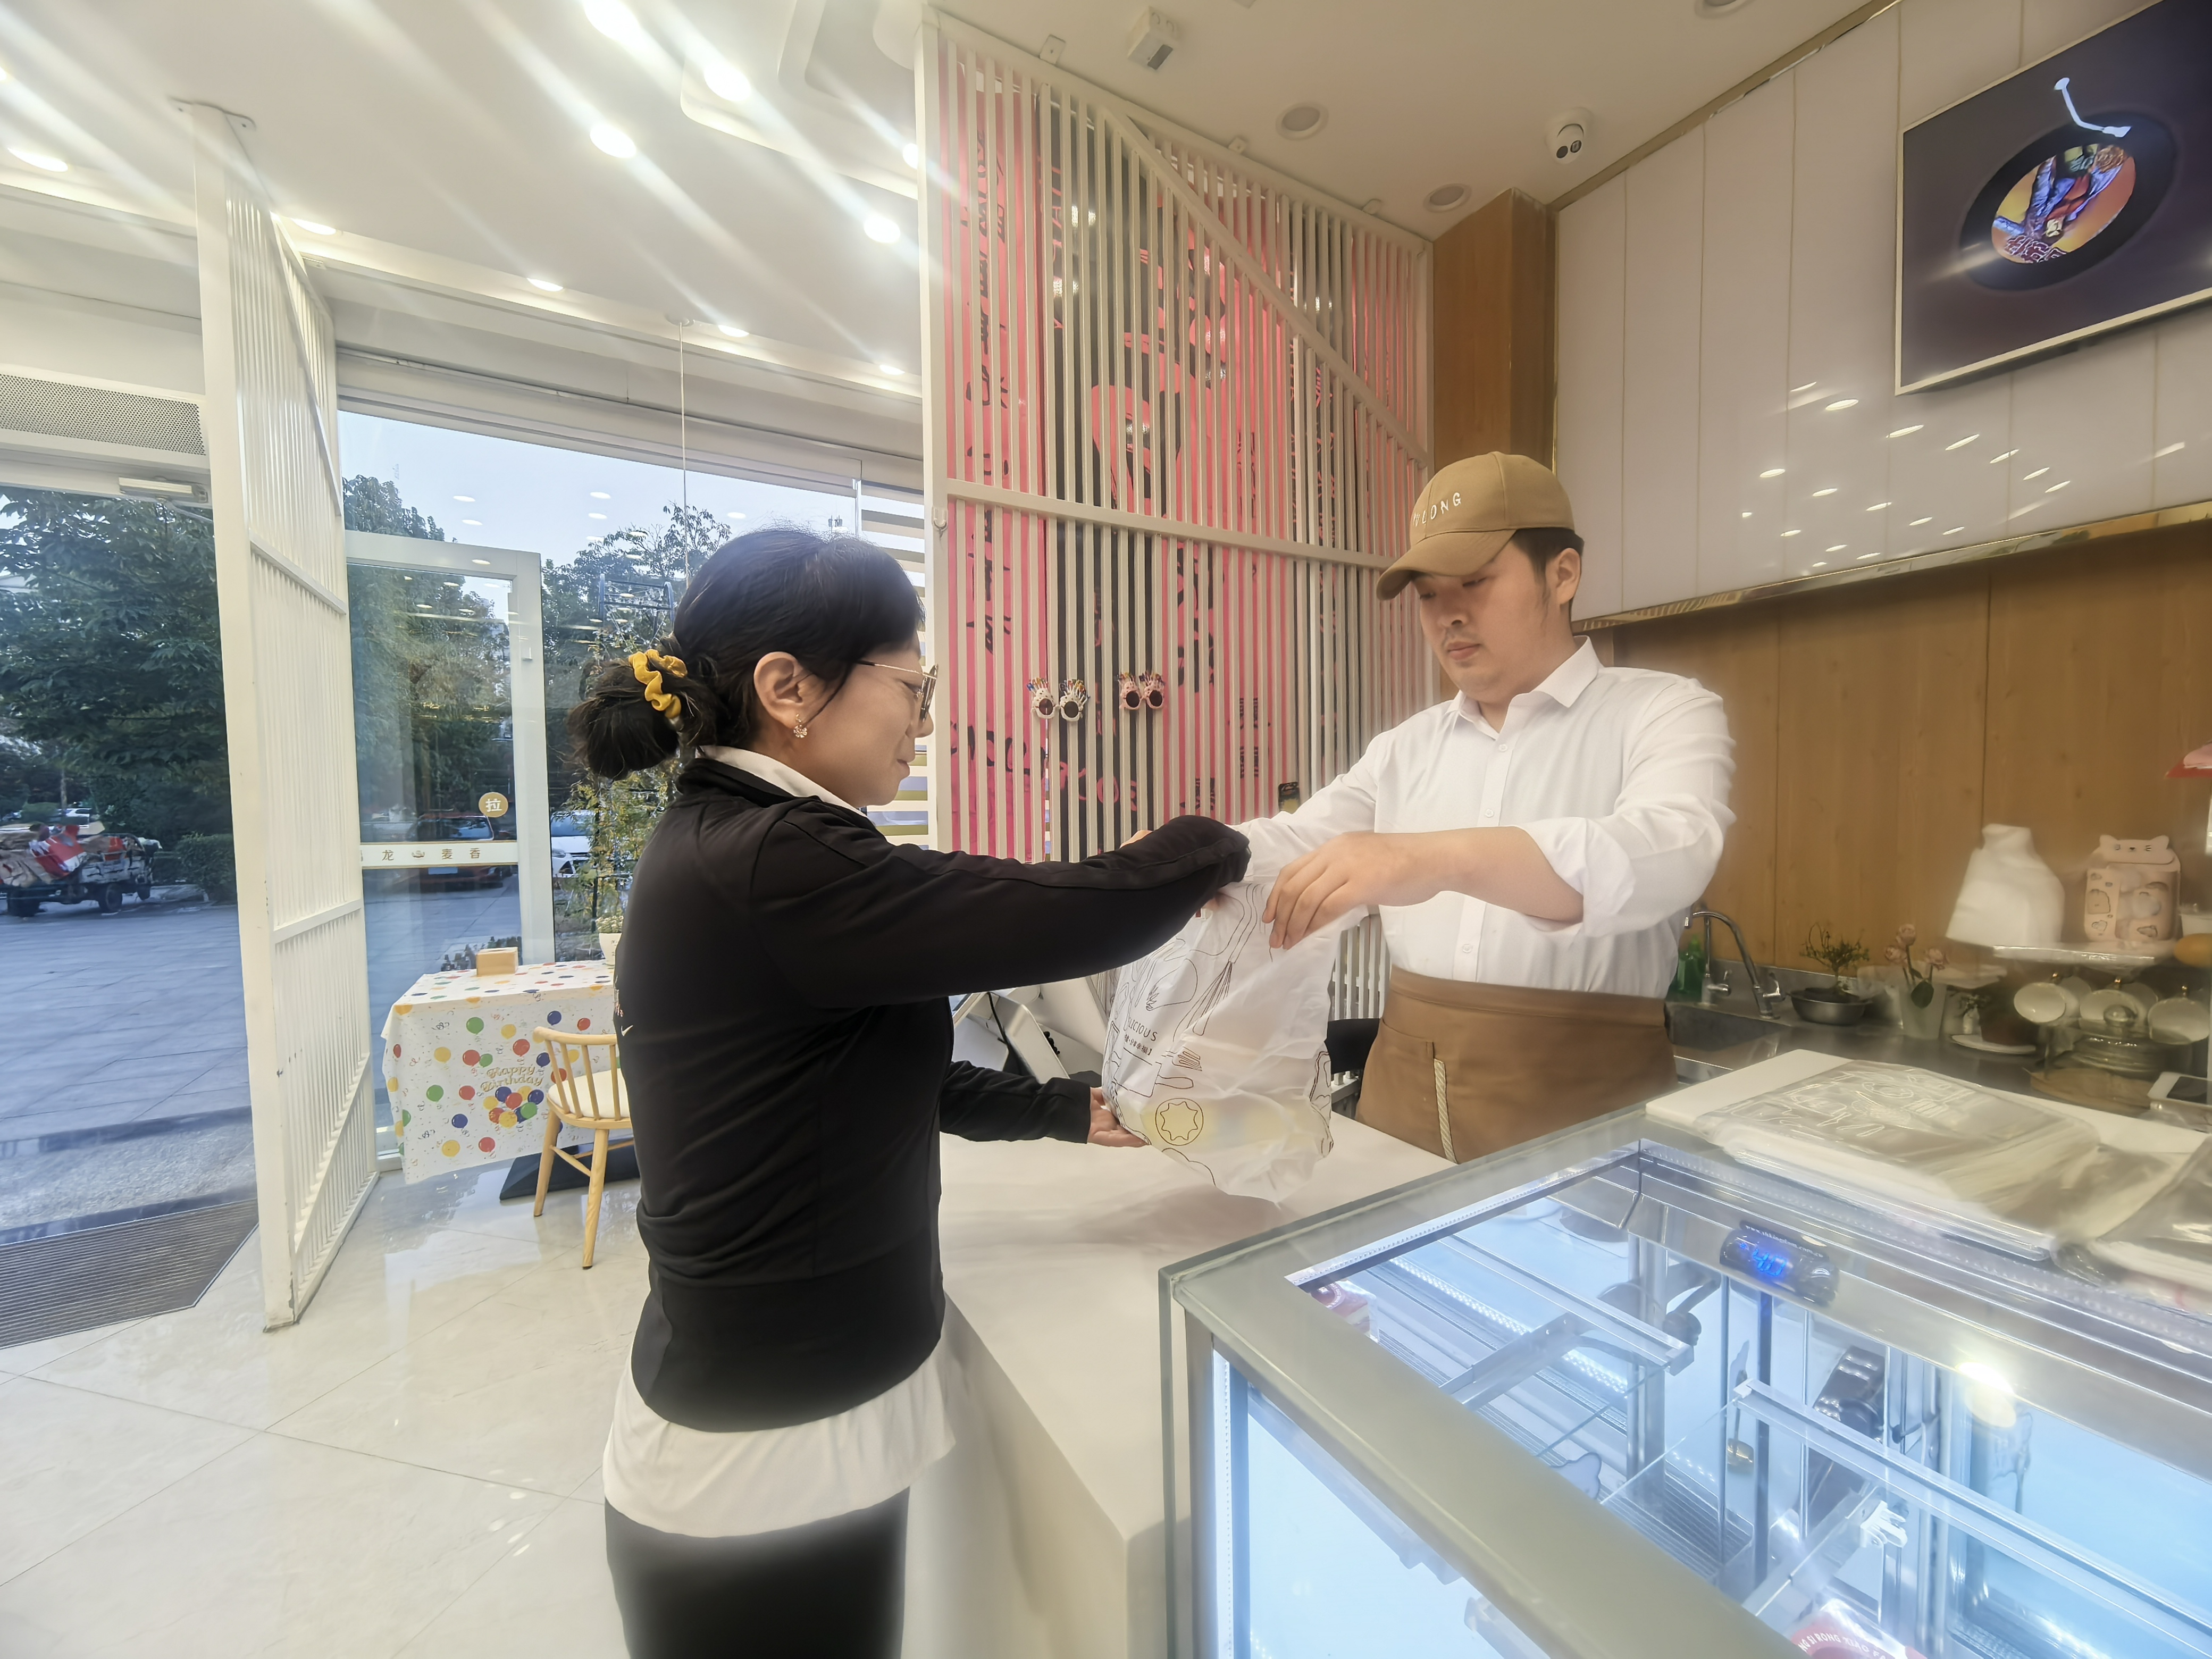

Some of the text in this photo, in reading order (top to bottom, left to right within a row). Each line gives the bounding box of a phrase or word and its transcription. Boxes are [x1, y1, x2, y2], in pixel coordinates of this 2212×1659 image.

[485, 798, 503, 812] 拉
[441, 848, 481, 860] 麦香
[1128, 1017, 1158, 1041] LICIOUS
[487, 1064, 535, 1079] Happy
[480, 1074, 544, 1092] Birthday
[1806, 1635, 1817, 1645] SI
[1814, 1632, 1842, 1643] RONG
